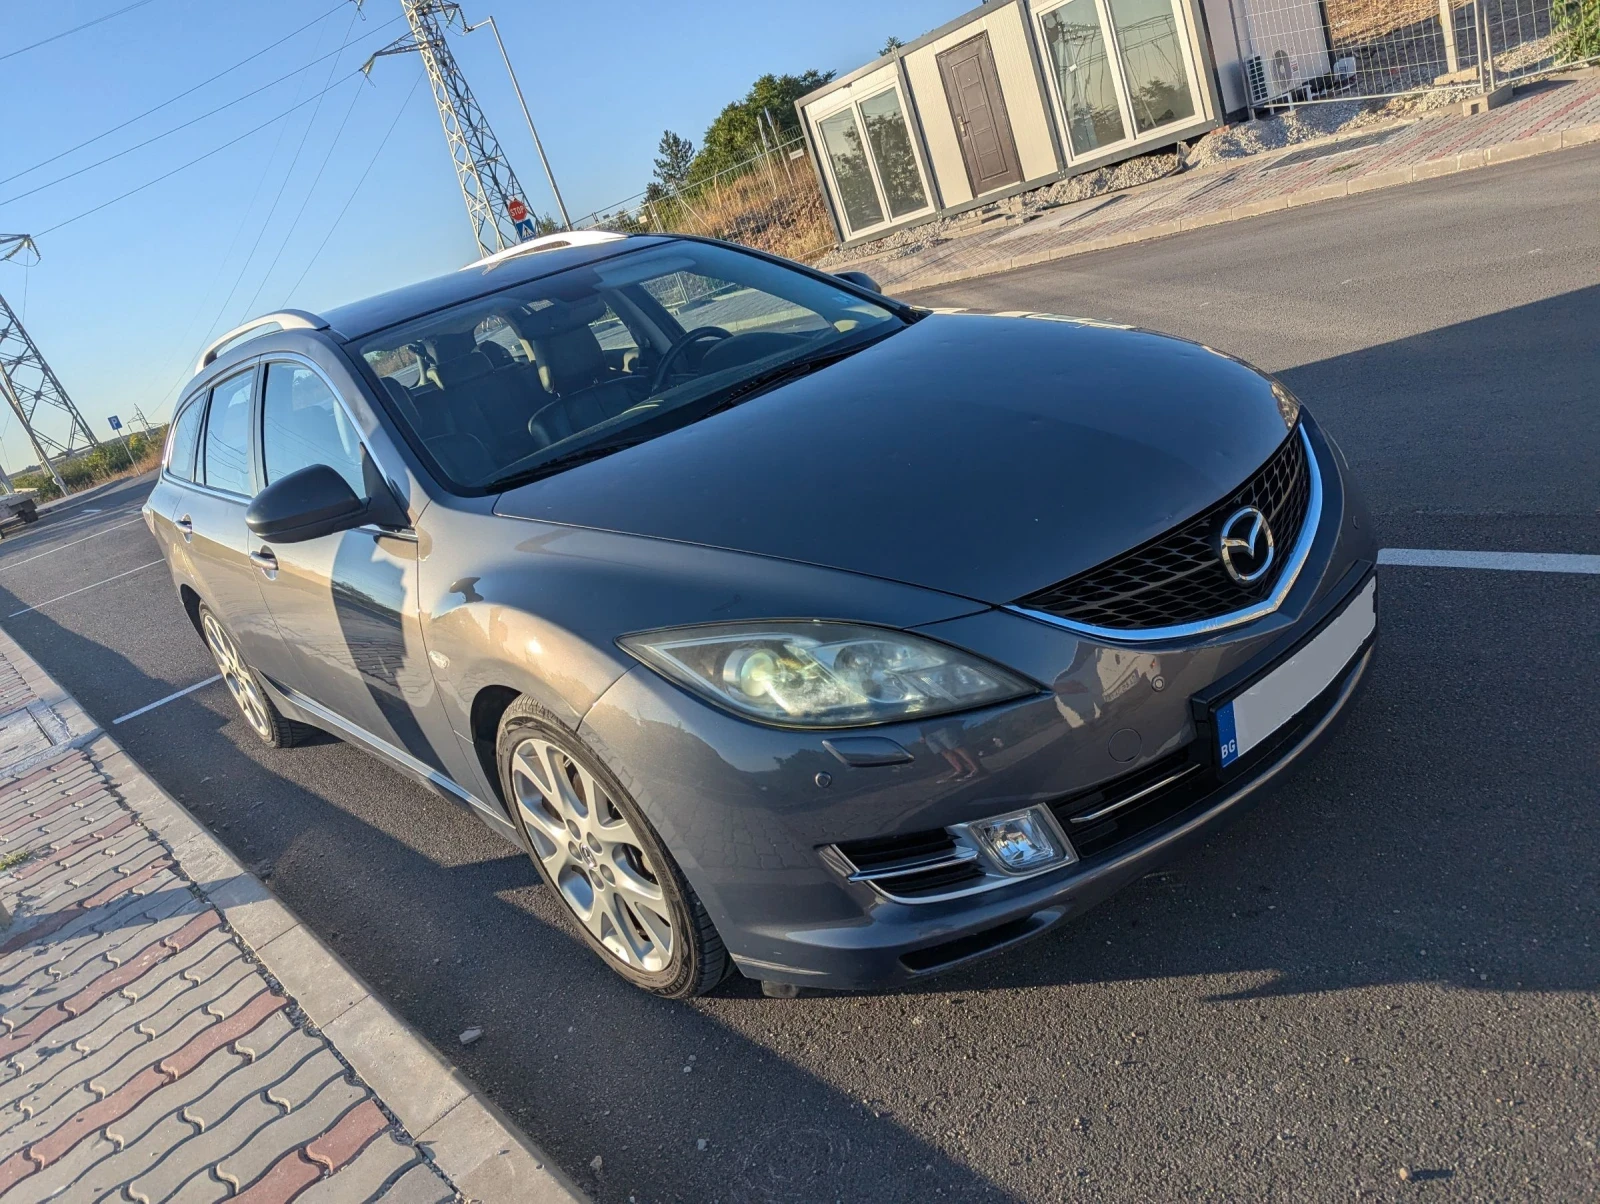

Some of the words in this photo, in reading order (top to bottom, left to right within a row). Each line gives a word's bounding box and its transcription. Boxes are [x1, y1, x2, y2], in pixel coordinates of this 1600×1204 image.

[510, 205, 524, 217] STOP
[111, 417, 118, 428] P
[1221, 739, 1236, 759] BG
